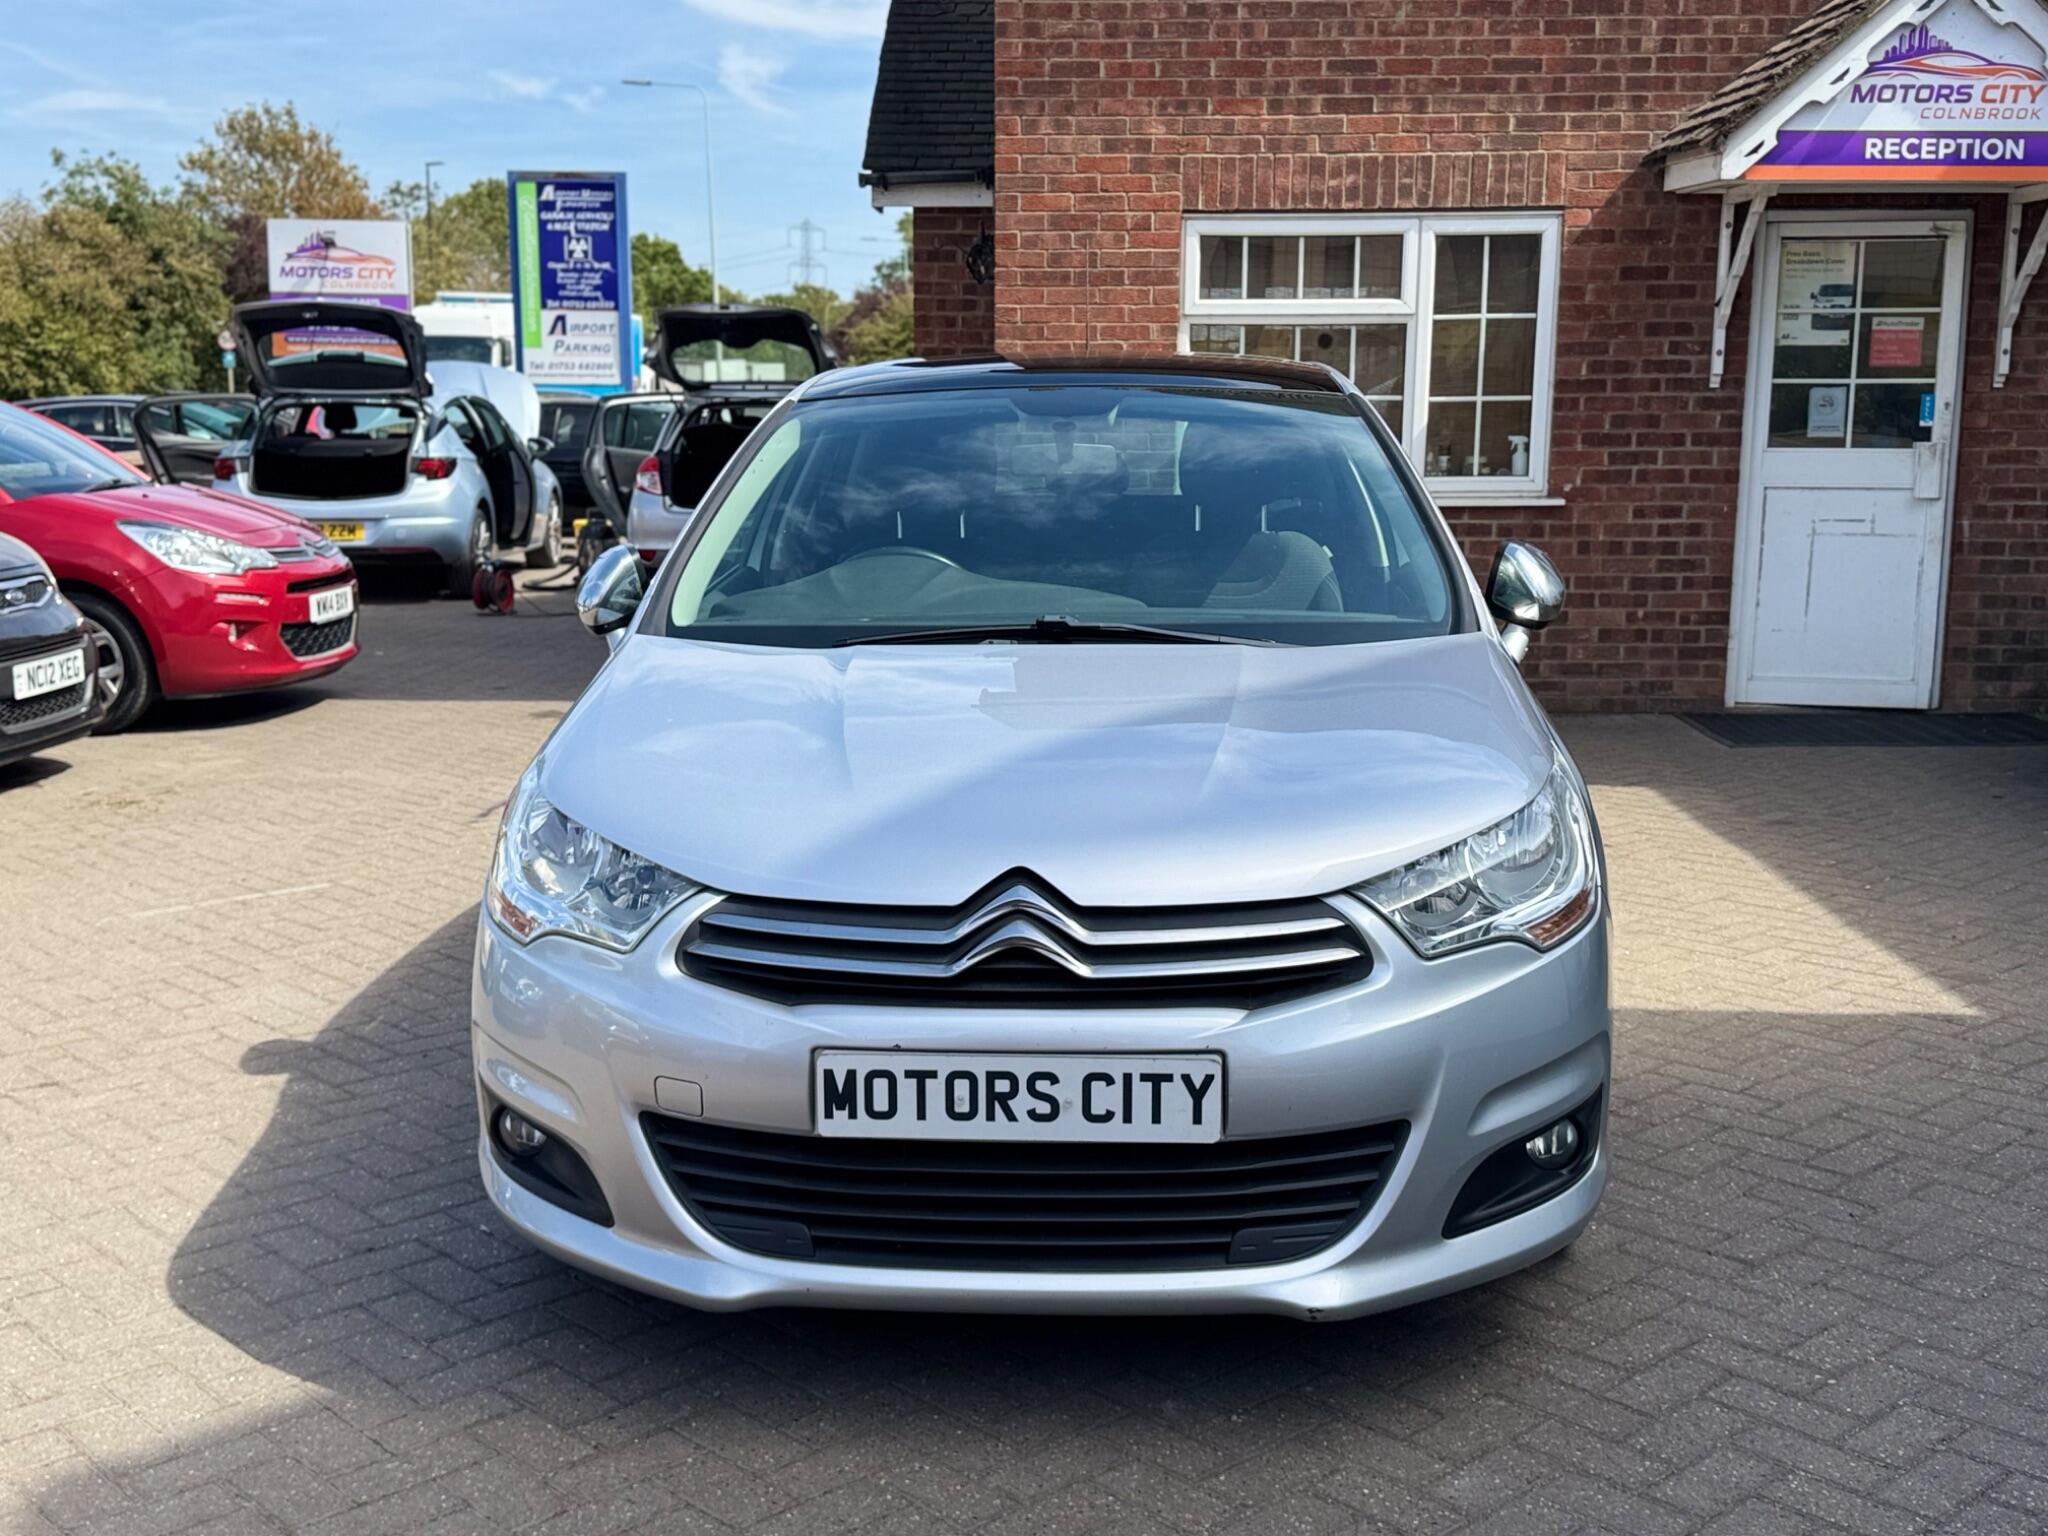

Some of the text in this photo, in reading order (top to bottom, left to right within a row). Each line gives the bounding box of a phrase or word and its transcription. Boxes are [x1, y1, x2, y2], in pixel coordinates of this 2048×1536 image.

[1850, 83, 2047, 105] MOTORS CITY
[1920, 107, 2042, 120] COLNBROOK
[1864, 137, 2026, 160] RECEPTION
[279, 266, 397, 280] MOTORS CITY
[548, 314, 616, 336] AIRPORT
[554, 340, 612, 353] PARKING
[26, 655, 80, 691] NC12 XEG
[822, 1068, 1216, 1126] MOTORS CITY
